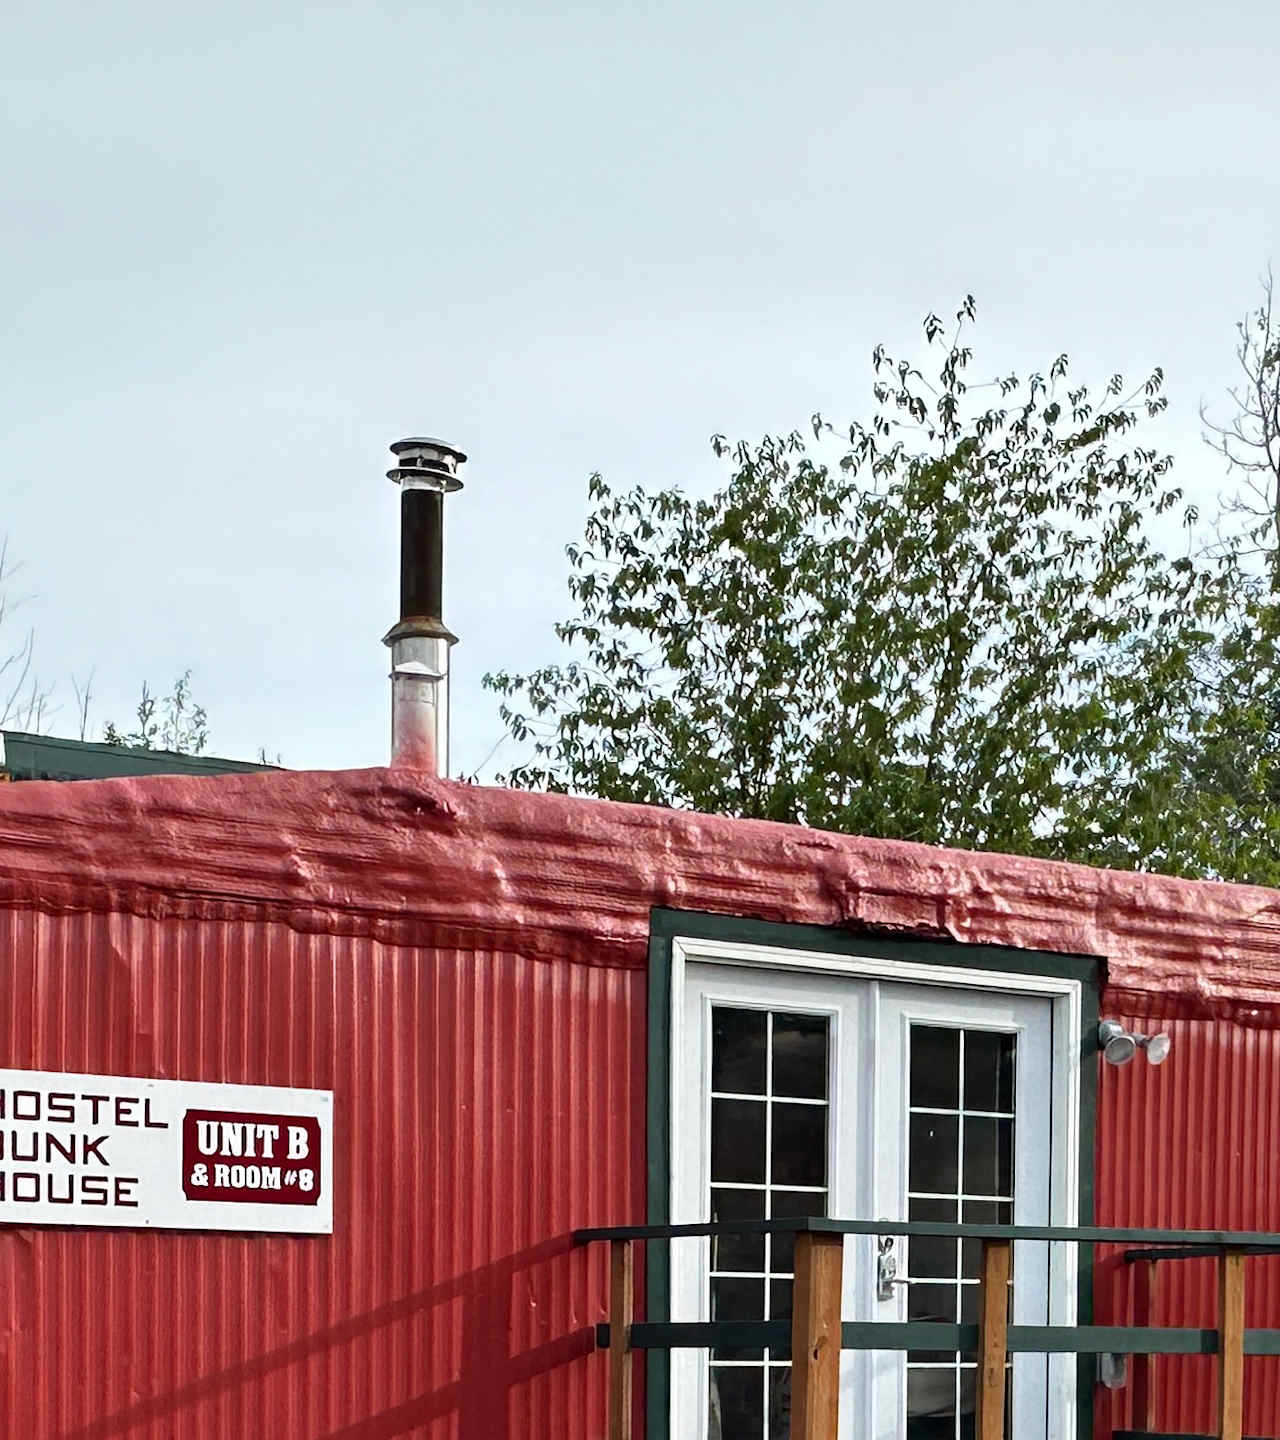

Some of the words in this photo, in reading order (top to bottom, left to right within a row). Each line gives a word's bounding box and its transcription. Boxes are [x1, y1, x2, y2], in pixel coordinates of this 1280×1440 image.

[196, 1120, 280, 1159] UNIT
[286, 1125, 310, 1160] B
[190, 1163, 209, 1187] &
